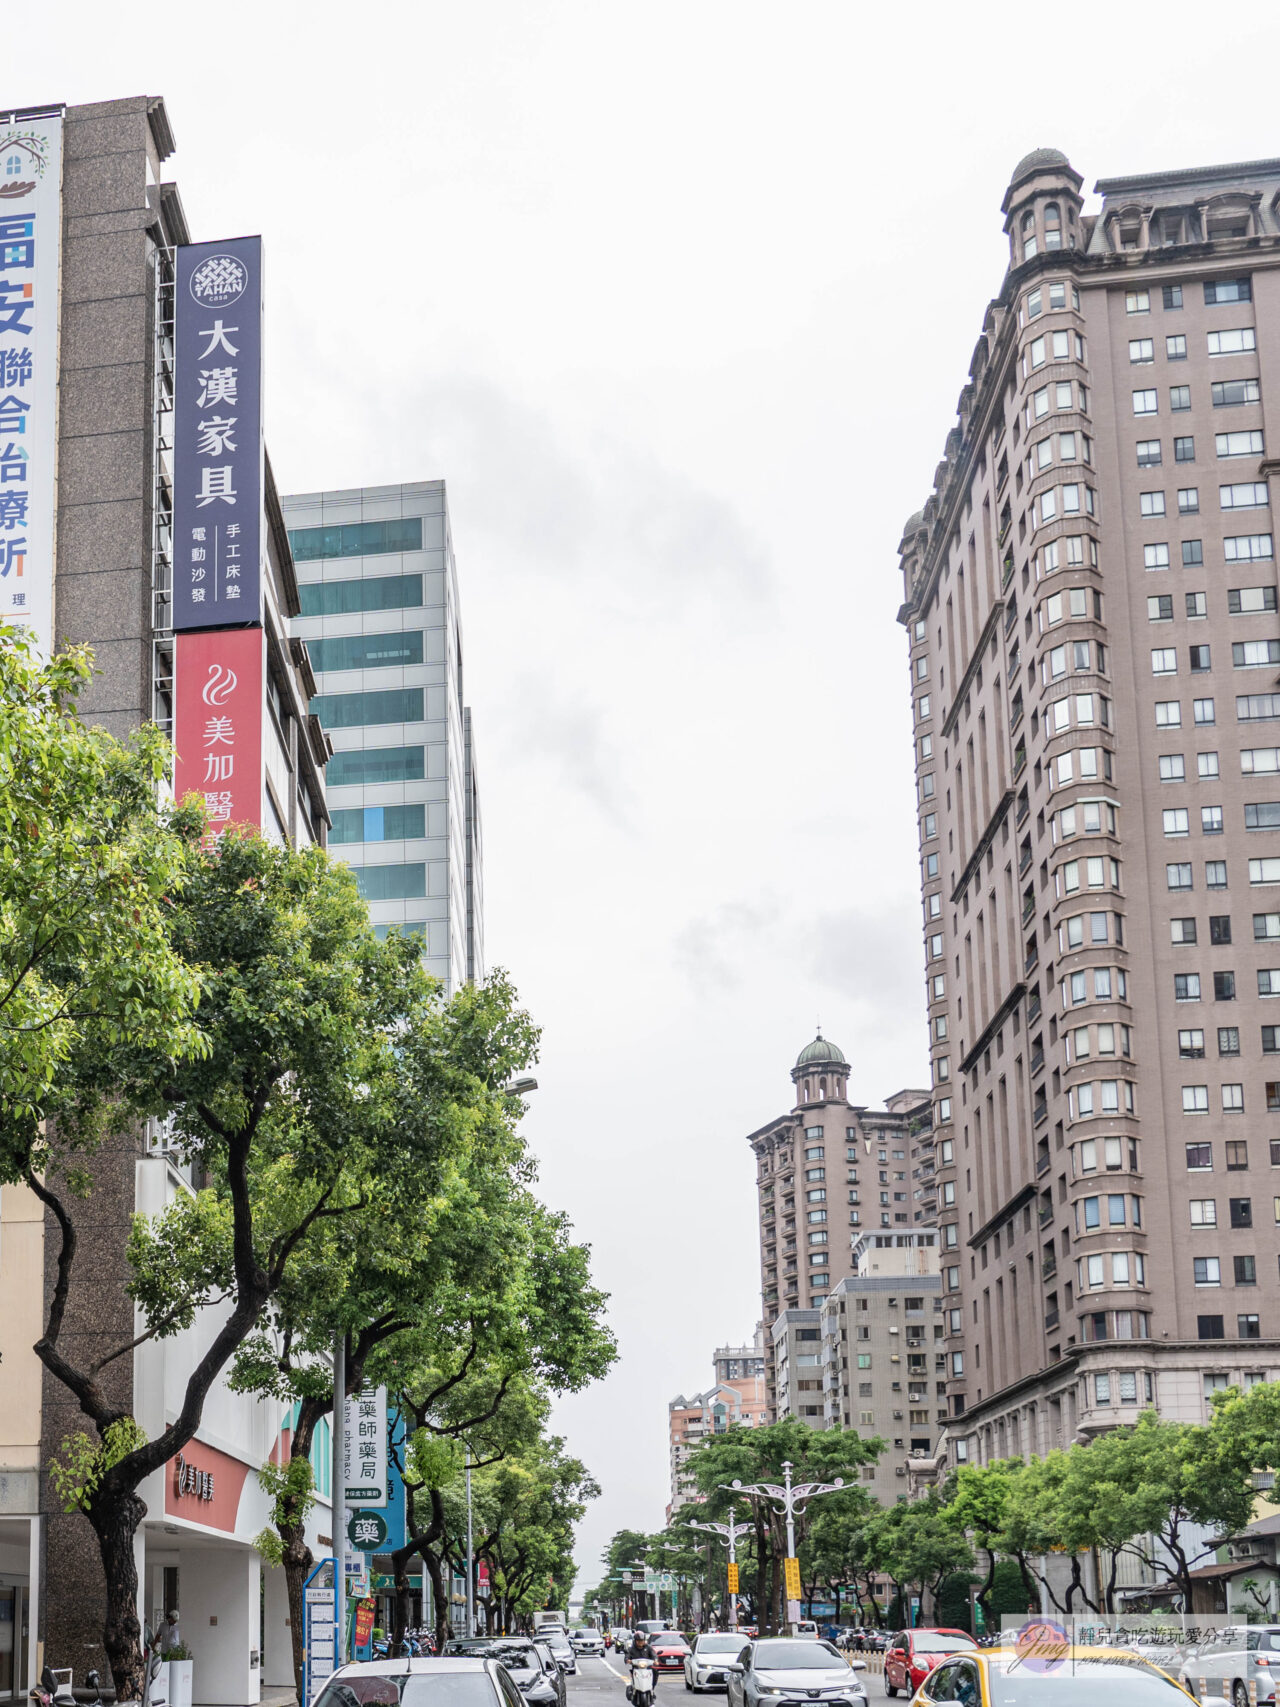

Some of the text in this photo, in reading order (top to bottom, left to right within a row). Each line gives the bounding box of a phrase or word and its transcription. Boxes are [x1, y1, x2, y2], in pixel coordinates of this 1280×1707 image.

[195, 279, 243, 298] TAHAN
[208, 294, 228, 302] casa
[195, 319, 241, 508] 大漢家具
[191, 527, 207, 603] 電動沙發
[225, 523, 241, 600] 手工床墊
[354, 1518, 381, 1544] 藥
